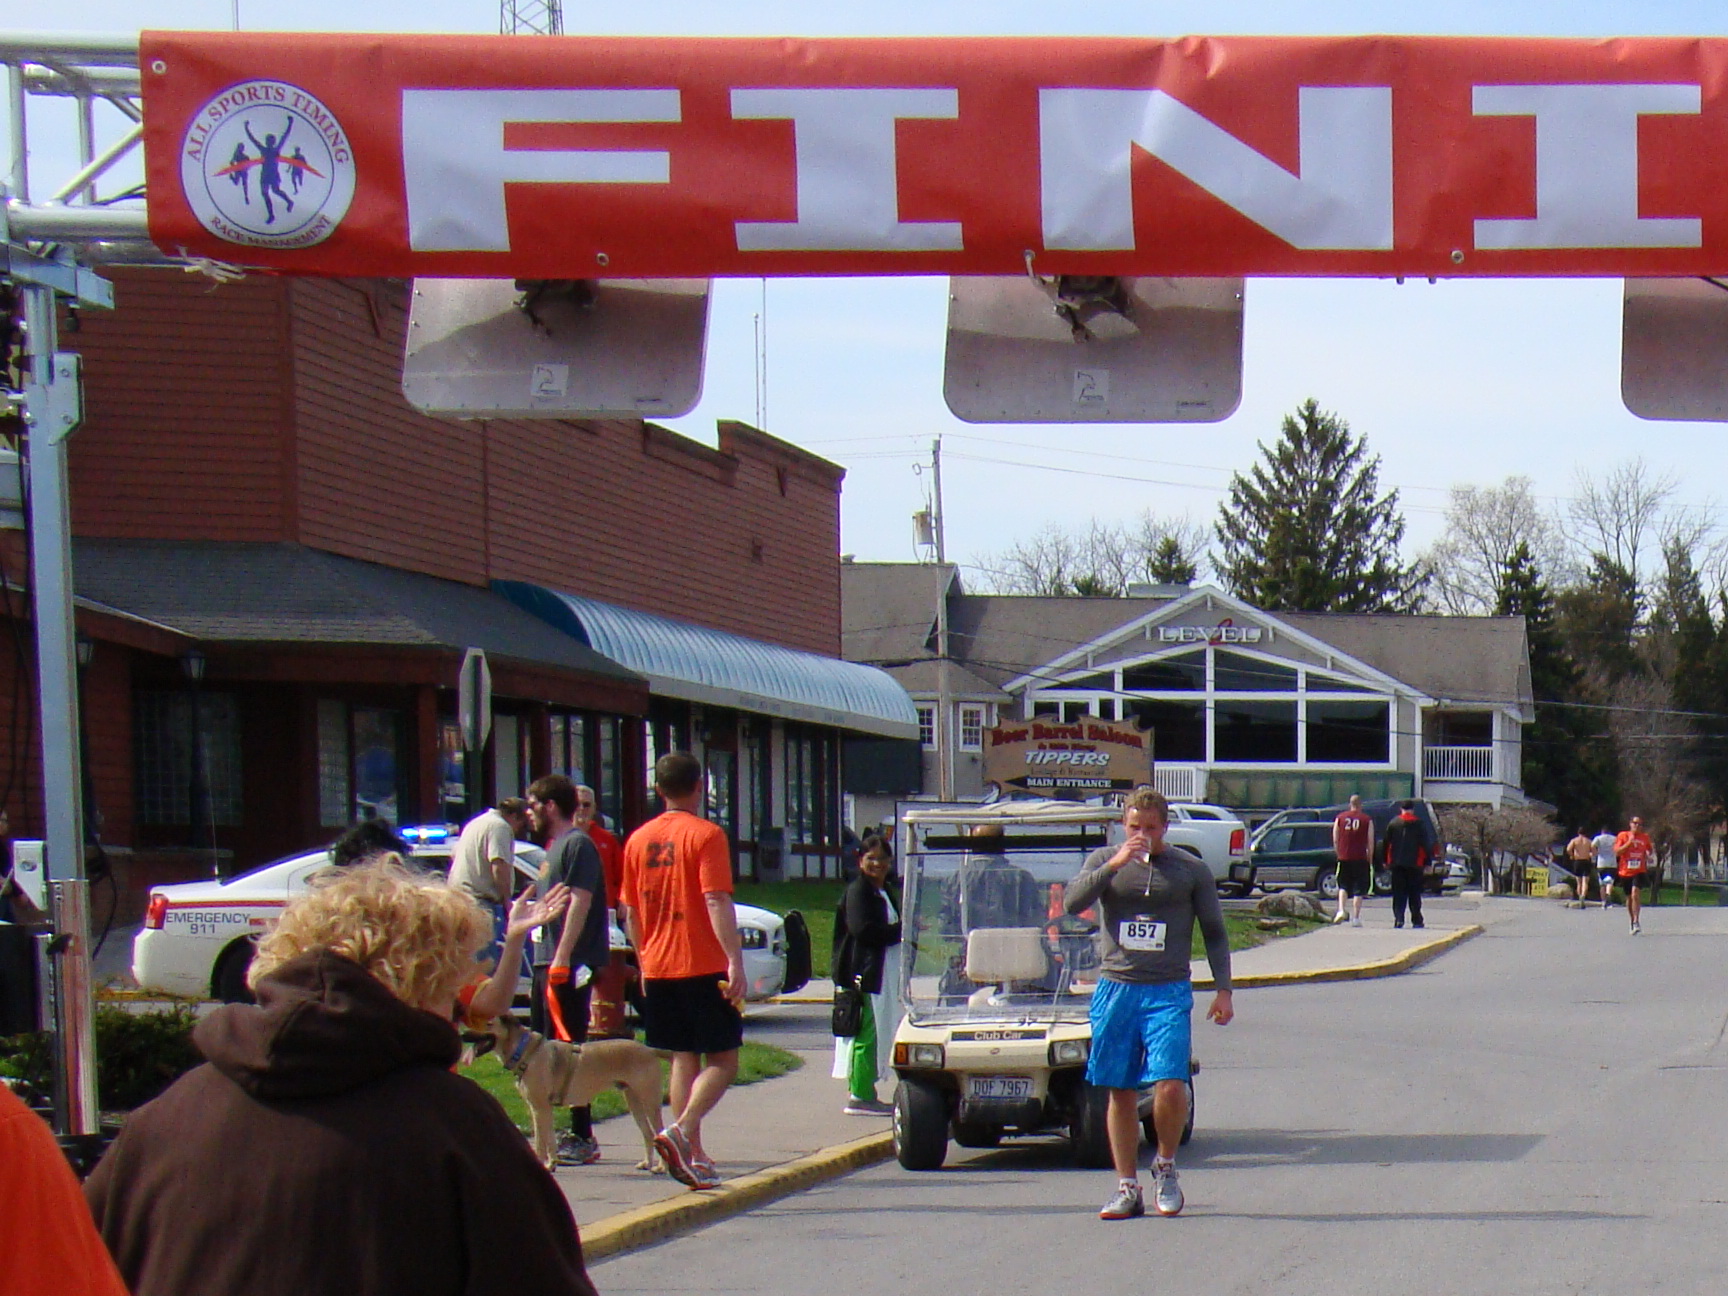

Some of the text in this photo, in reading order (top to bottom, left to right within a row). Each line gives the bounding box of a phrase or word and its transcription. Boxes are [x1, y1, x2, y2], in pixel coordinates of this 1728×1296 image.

[187, 85, 349, 165] ALL SPORTS TIMING
[212, 216, 244, 240] RACE
[1158, 627, 1261, 642] LEVEL
[992, 728, 1029, 746] Beer
[1032, 723, 1084, 740] Barrel
[1088, 724, 1143, 748] Saloon
[1025, 751, 1110, 766] TIPPERS
[1027, 777, 1112, 788] MAIN ENTRANCE
[1344, 818, 1360, 831] 20
[646, 842, 675, 868] 23
[166, 912, 251, 924] EMERGENCY
[190, 924, 215, 934] 911
[1127, 923, 1157, 939] 857
[974, 1030, 1024, 1040] Club Car
[1000, 1080, 1029, 1096] 7967
